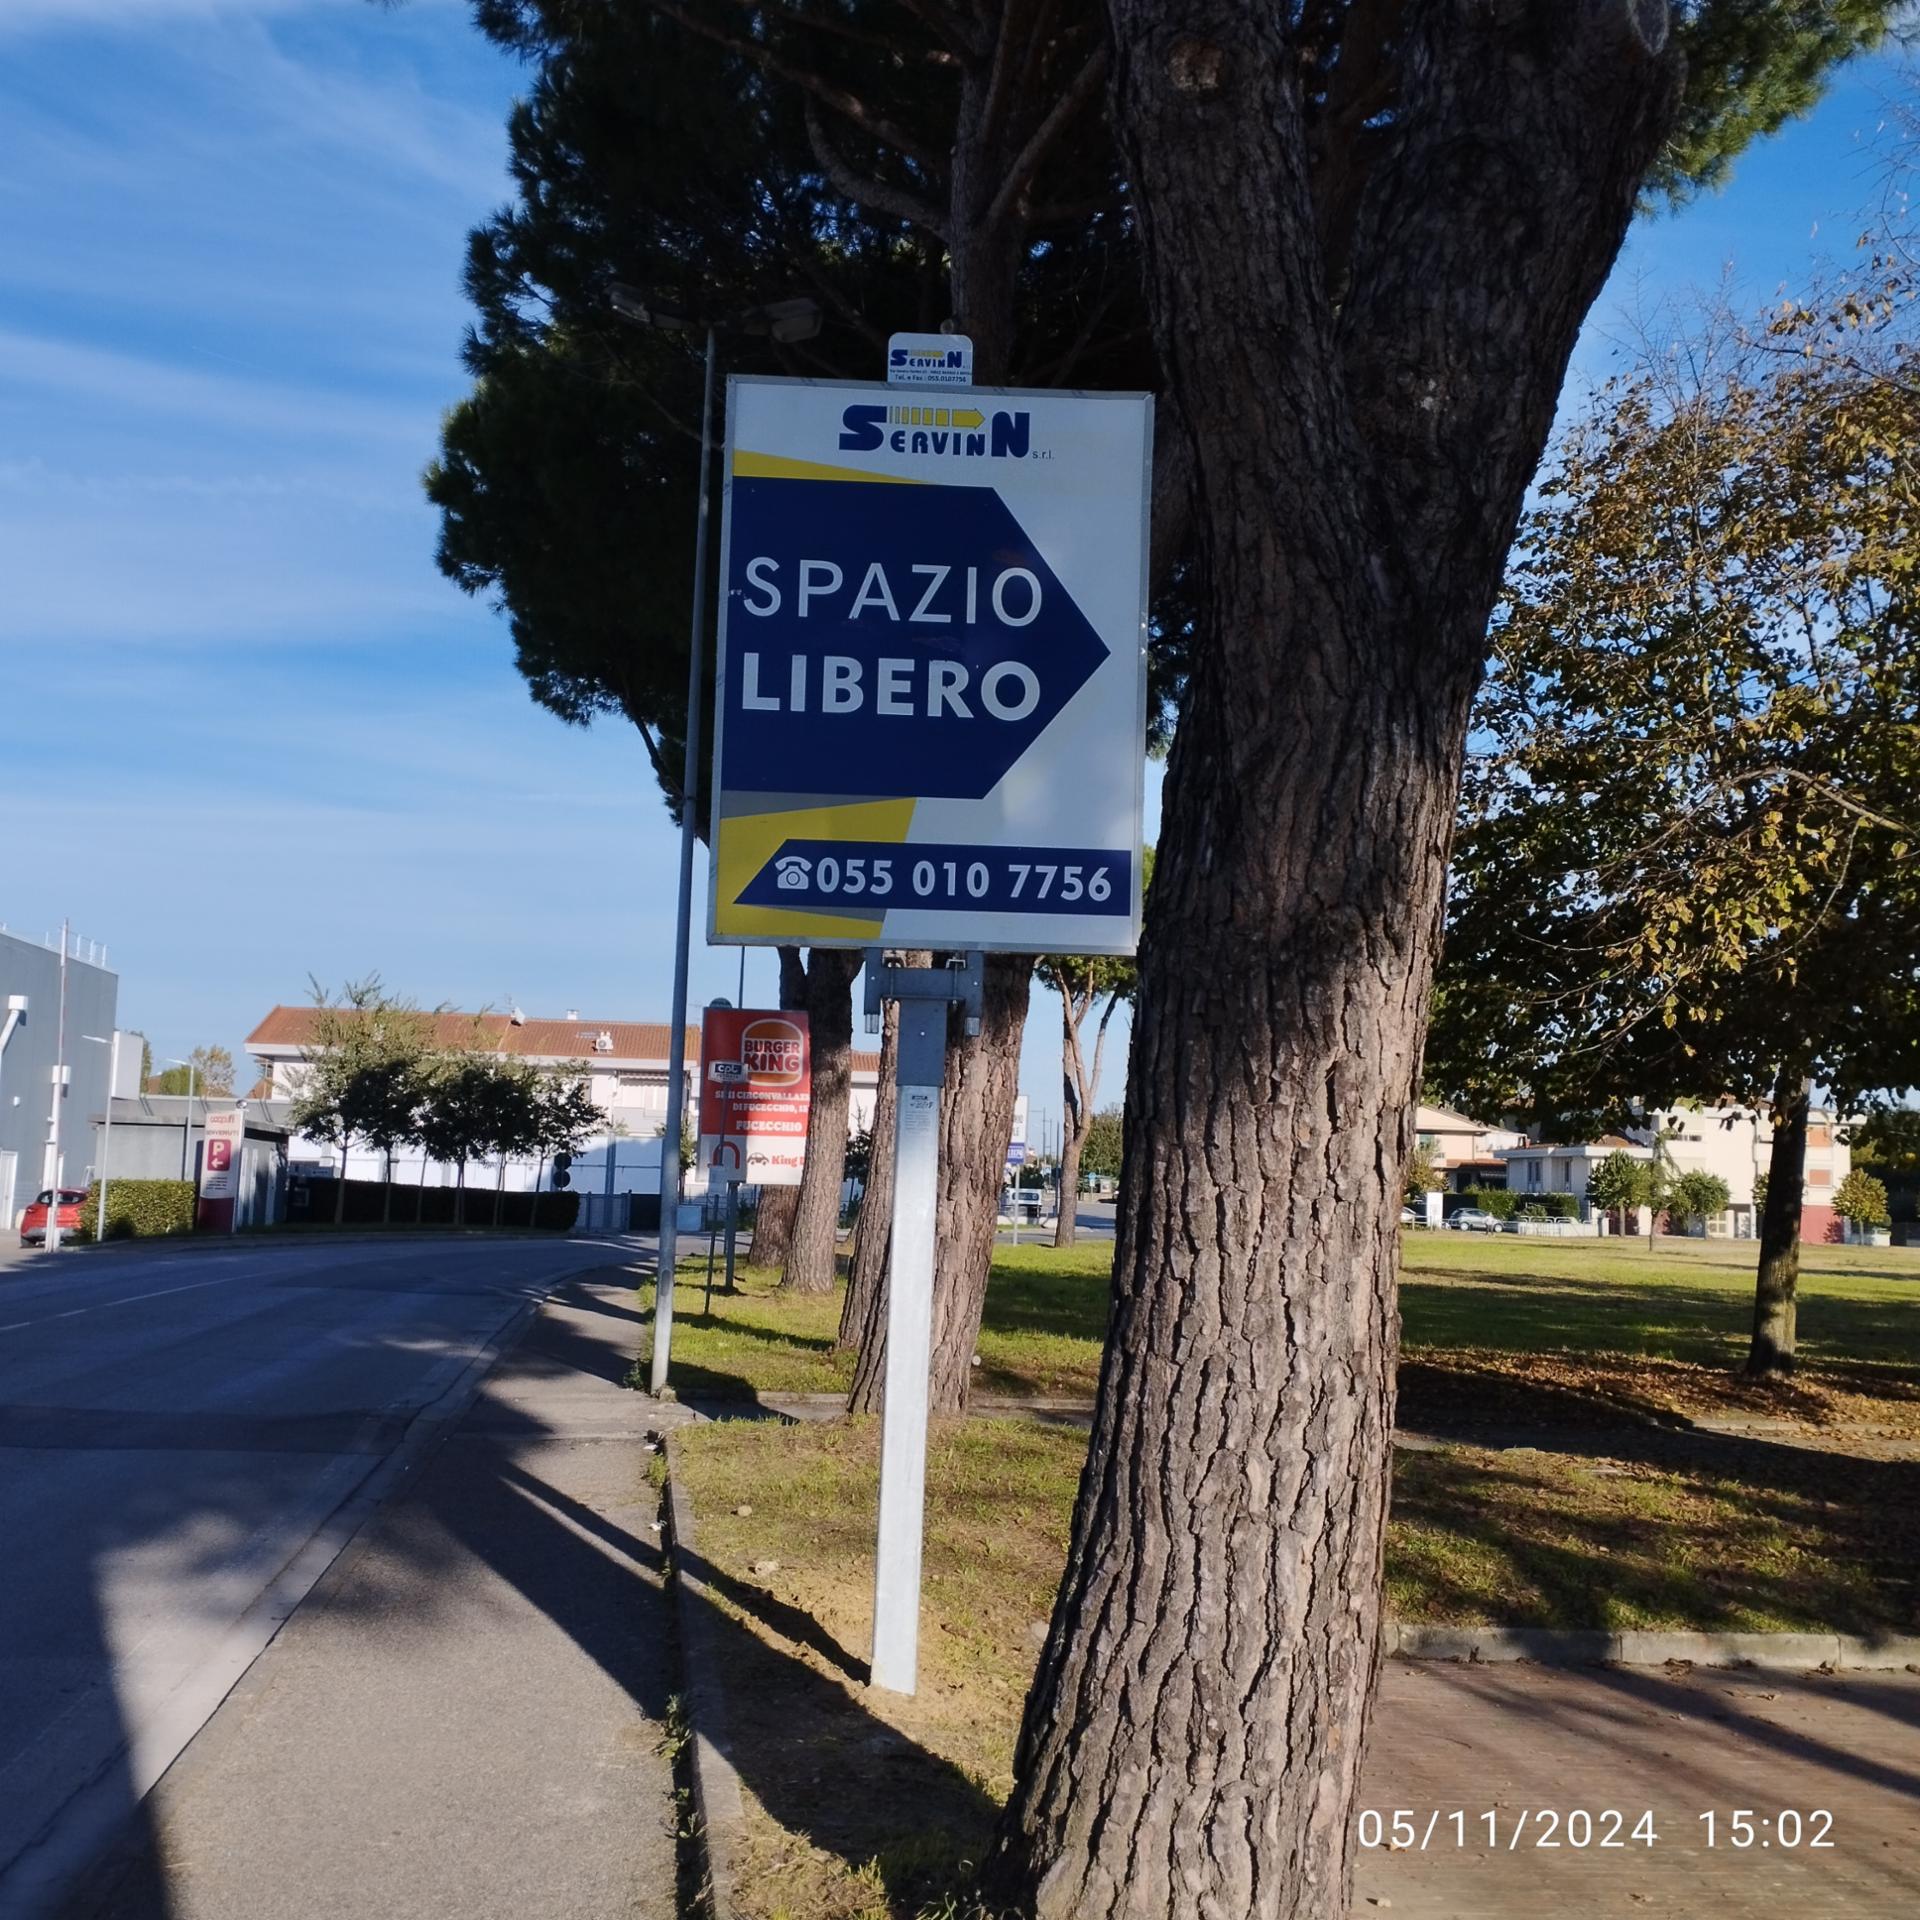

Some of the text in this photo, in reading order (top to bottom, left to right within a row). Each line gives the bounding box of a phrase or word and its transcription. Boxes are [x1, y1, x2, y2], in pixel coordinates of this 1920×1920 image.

[744, 556, 1042, 627] SPAZIO
[741, 652, 1041, 721] LIBERO
[816, 857, 1112, 902] 055 010 7756
[744, 1039, 800, 1054] BURGER
[744, 1053, 799, 1072] KING
[736, 1120, 802, 1132] FUCECCHIO
[771, 1154, 797, 1168] King
